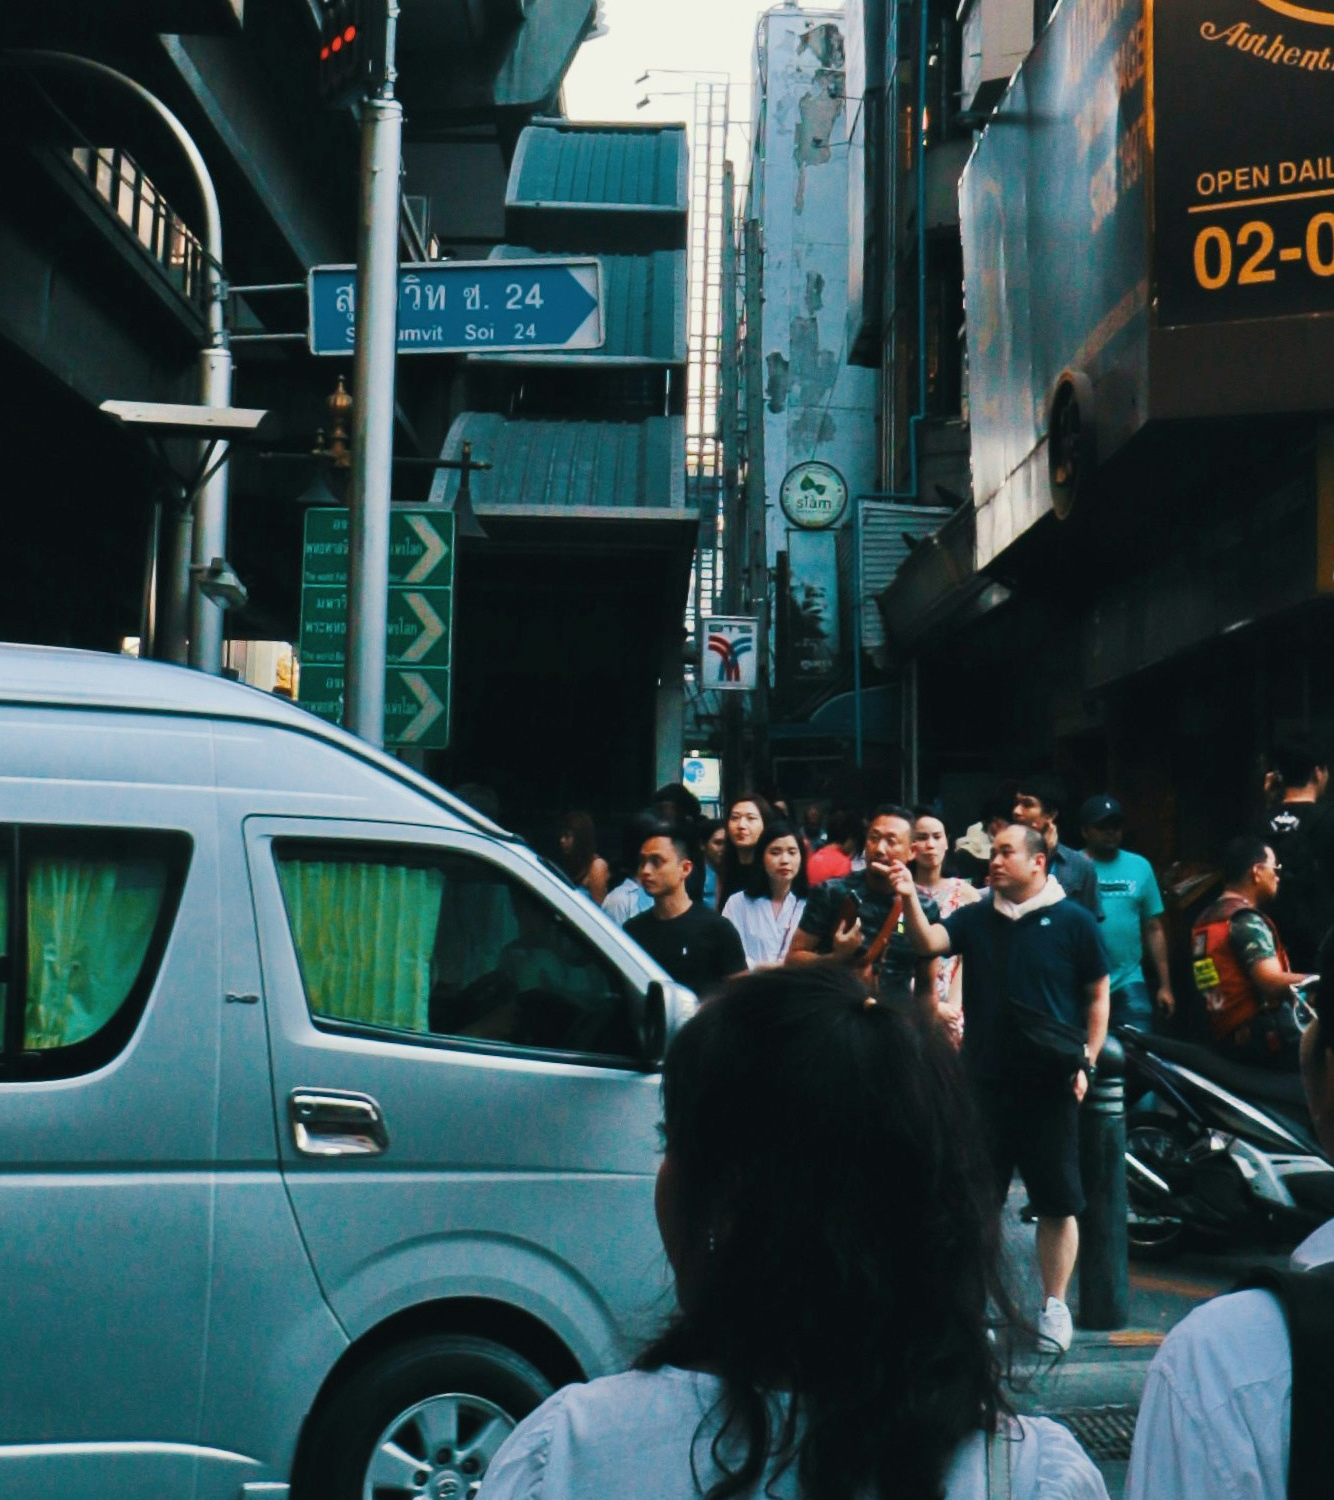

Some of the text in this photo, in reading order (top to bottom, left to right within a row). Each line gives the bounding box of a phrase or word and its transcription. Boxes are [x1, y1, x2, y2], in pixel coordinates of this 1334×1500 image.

[1196, 163, 1271, 197] OPEN
[505, 282, 545, 310] 24
[464, 322, 495, 341] Soi
[514, 322, 537, 340] 24
